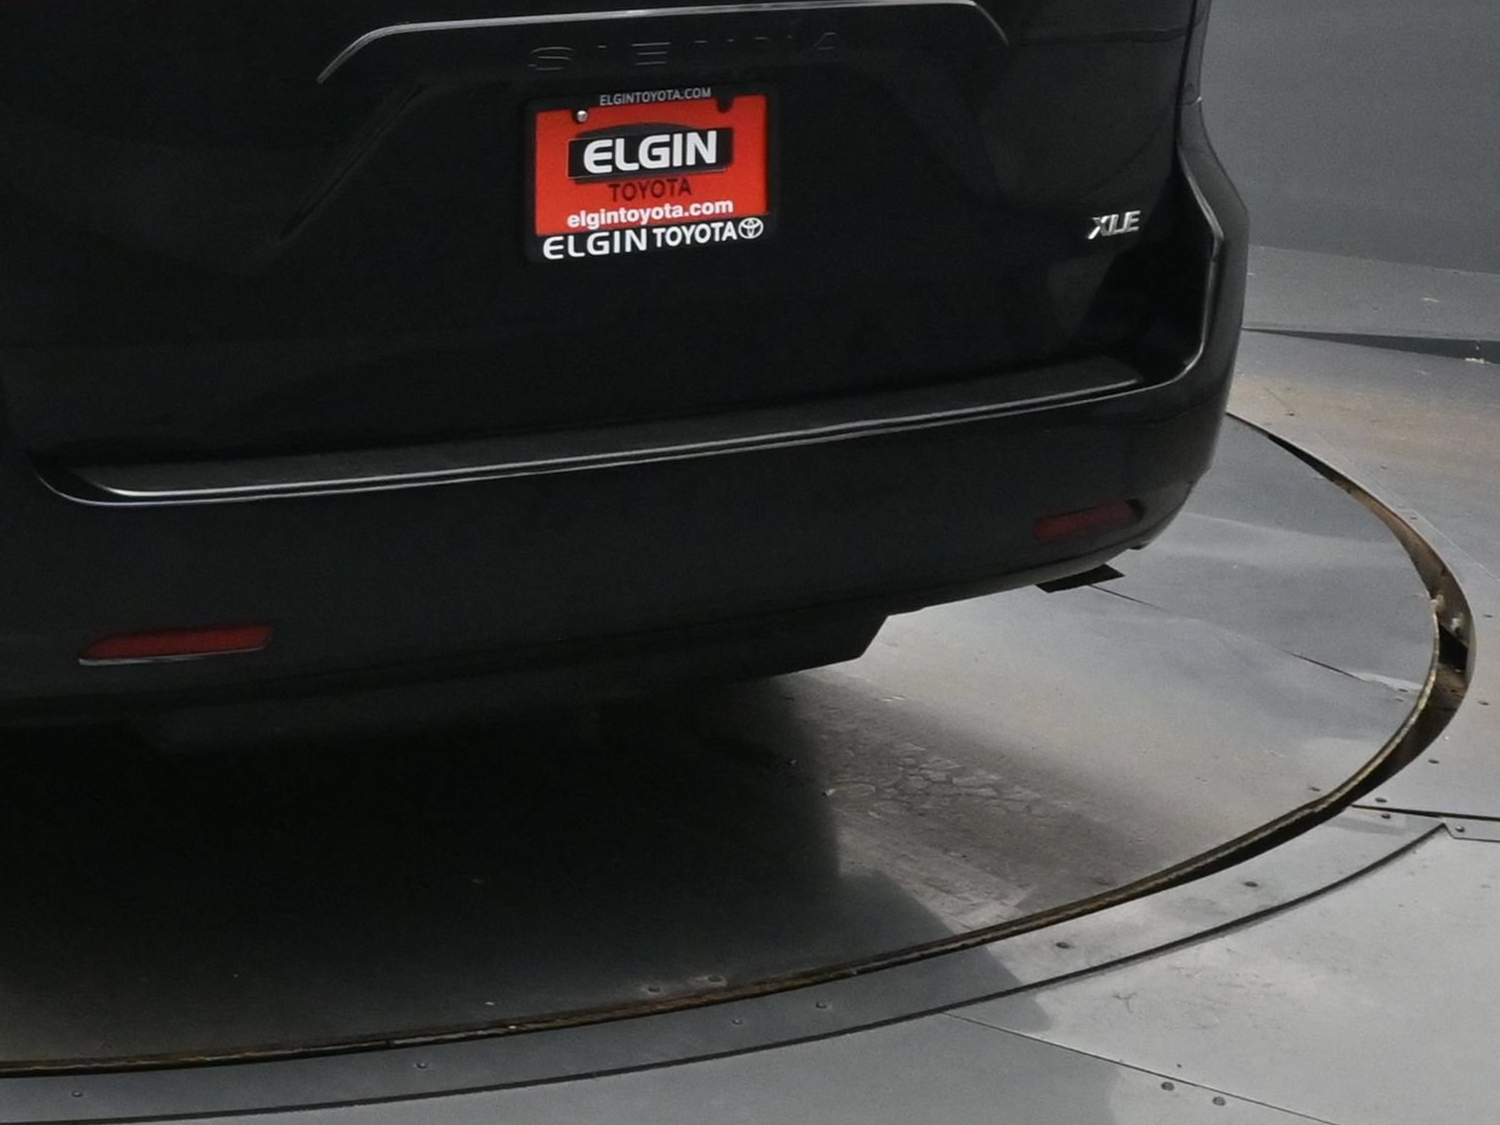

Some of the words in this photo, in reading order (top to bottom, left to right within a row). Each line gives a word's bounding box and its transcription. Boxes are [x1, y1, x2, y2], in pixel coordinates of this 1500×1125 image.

[599, 87, 712, 106] ELGINTOYOTA.COM
[583, 130, 717, 174] ELGIN
[608, 178, 692, 202] TOYOTA
[566, 200, 734, 231] elgintoyota.com
[1087, 209, 1141, 240] XLE
[542, 229, 648, 260] ELGIN
[653, 221, 738, 248] TOYOTA
